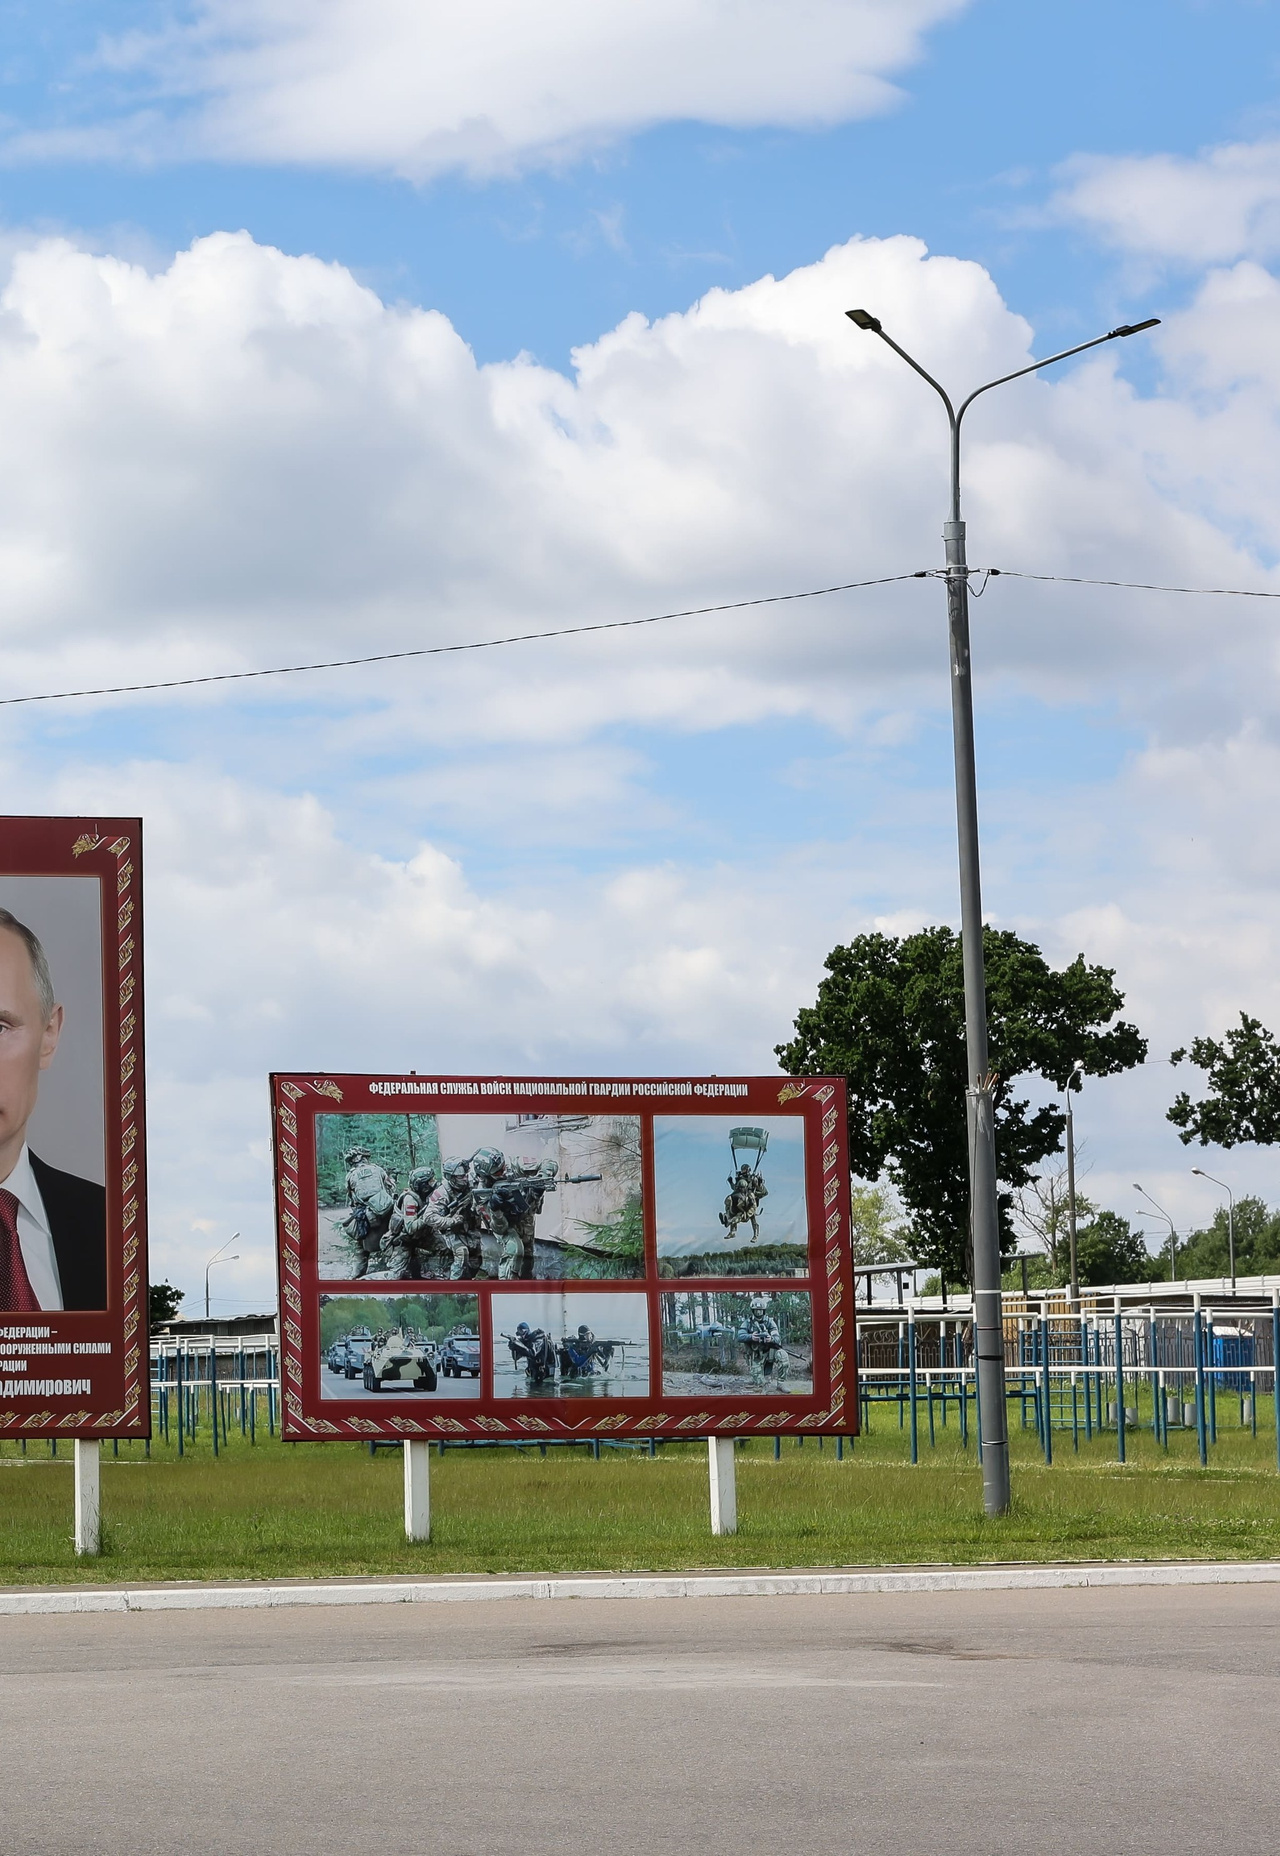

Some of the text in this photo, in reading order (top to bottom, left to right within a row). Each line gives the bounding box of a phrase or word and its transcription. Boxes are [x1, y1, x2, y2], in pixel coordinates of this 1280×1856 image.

[368, 1081, 749, 1098] ФЕДЕРАЛЬНАЯ СЛУЖБА ВОЙСК НАЦИОНАЛЬНОЙ ГВАРДИИ РОССИЙСКОЙ ФЕДЕРАЦИИ
[73, 1342, 112, 1355] СИЛАМИ
